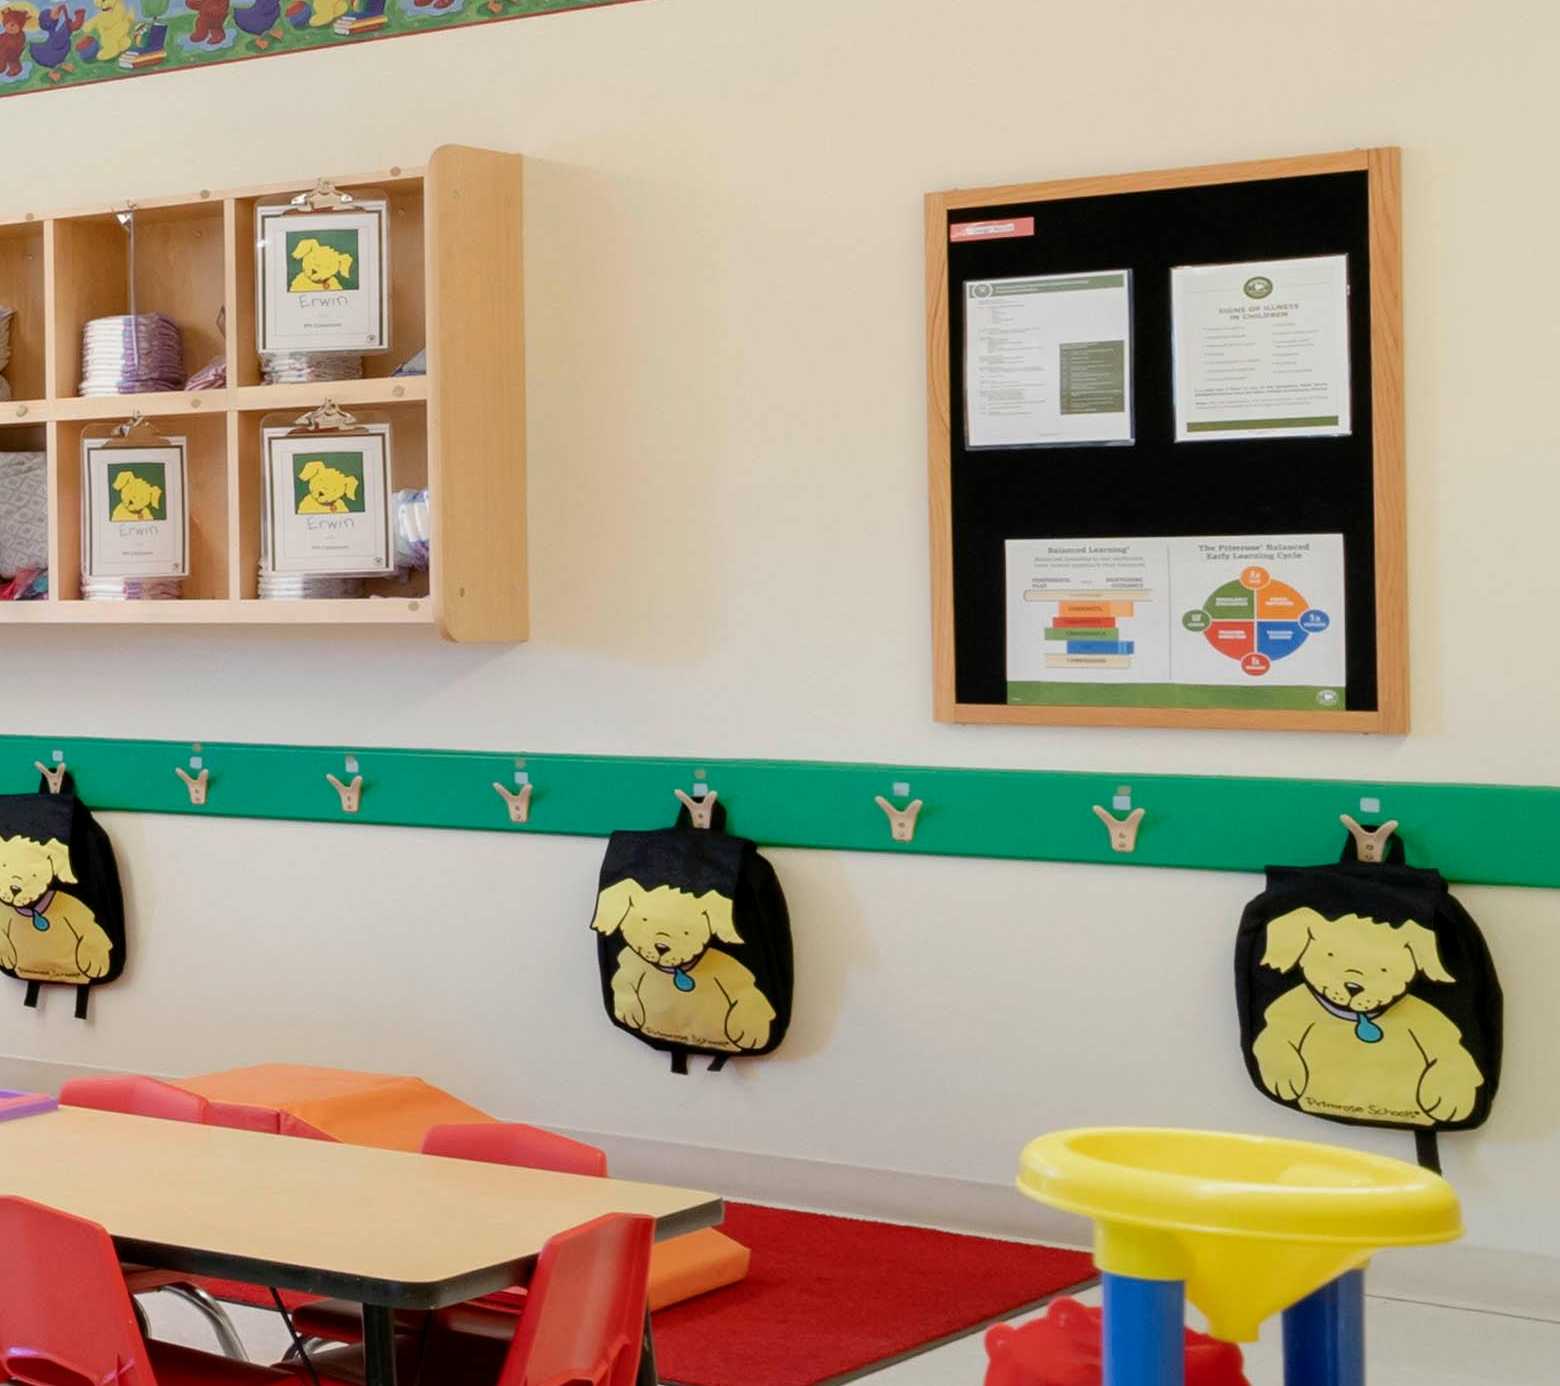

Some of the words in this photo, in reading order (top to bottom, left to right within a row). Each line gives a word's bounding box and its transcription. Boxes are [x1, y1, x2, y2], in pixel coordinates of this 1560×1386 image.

[300, 294, 348, 308] Erwin
[119, 524, 159, 537] Erwin
[306, 516, 355, 531] Erwin
[1305, 1096, 1364, 1113] Primrose
